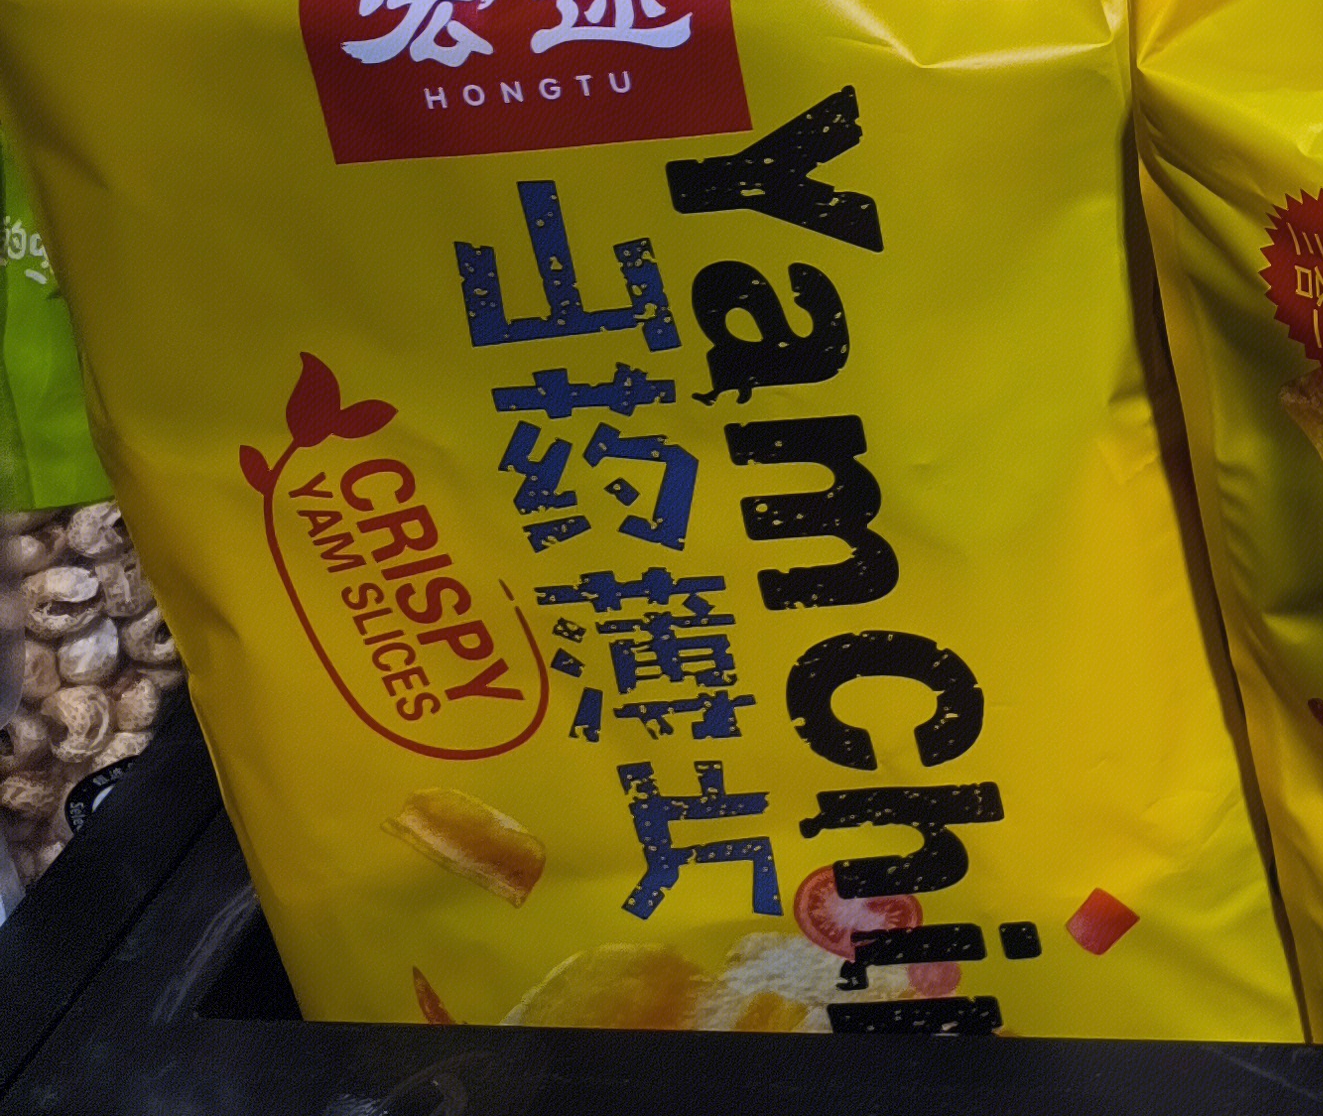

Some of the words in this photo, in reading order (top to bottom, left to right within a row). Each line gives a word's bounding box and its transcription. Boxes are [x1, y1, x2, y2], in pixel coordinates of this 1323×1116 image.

[423, 71, 633, 110] HONGTU
[288, 472, 367, 575] YAM
[341, 581, 441, 724] SLICES
[340, 458, 525, 708] CRISPY
[454, 181, 783, 920] 山药薄片
[664, 85, 900, 610] Yam
[784, 630, 1042, 1036] Chi
